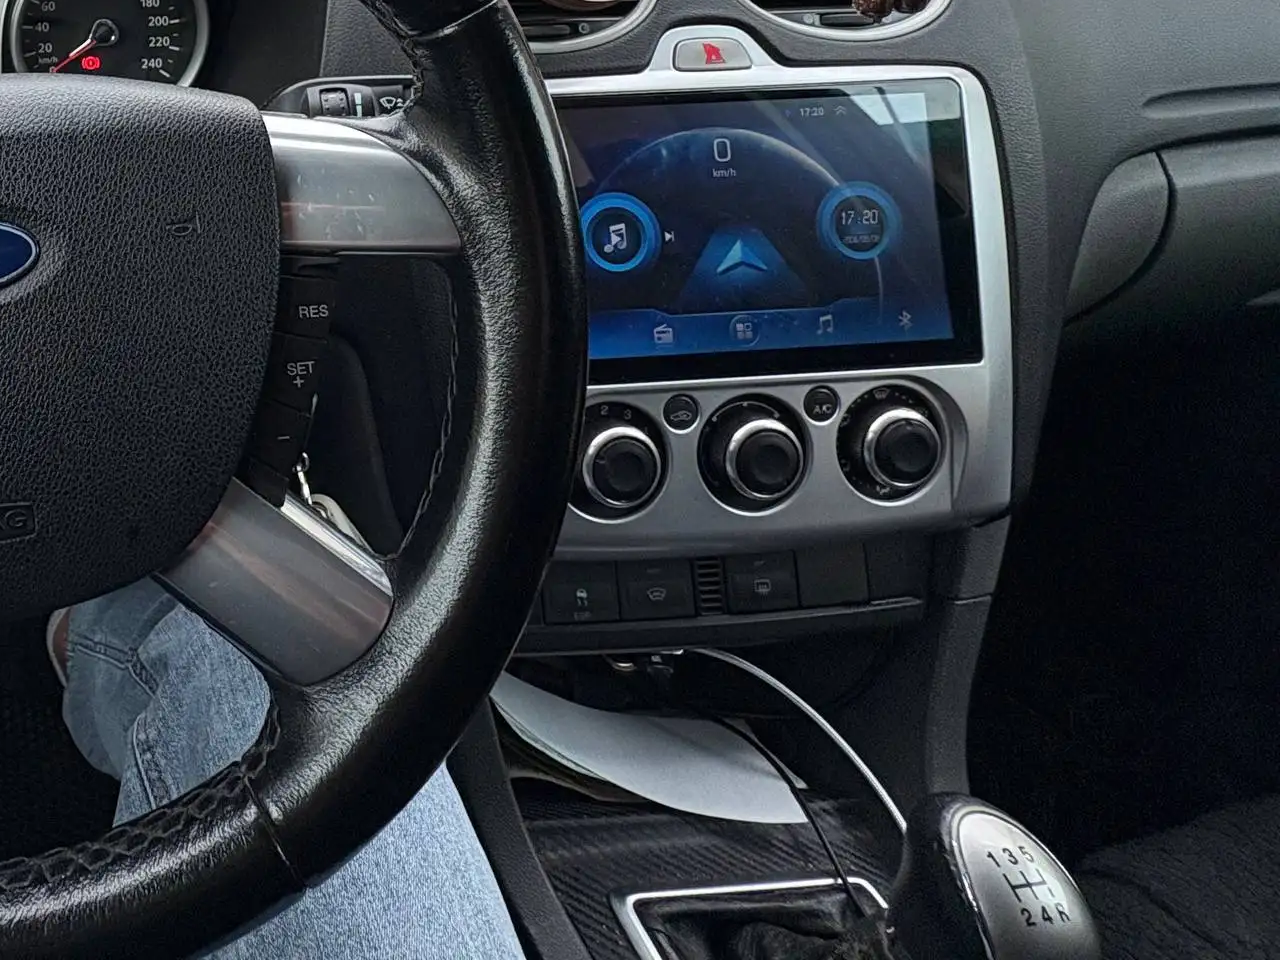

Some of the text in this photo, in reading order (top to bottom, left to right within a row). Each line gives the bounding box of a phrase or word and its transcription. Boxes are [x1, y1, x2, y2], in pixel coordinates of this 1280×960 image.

[41, 1, 56, 12] 60
[35, 22, 50, 32] 40
[148, 16, 169, 27] 200
[148, 36, 170, 47] 220
[38, 43, 53, 54] 20
[141, 58, 163, 69] 240
[799, 107, 825, 117] 17:20
[713, 138, 731, 162] 0
[712, 168, 737, 178] km/h
[841, 209, 879, 225] 17:20
[298, 304, 329, 319] RES
[286, 360, 315, 376] SET
[986, 845, 1035, 868] 1 3 5
[1020, 907, 1037, 927] 2
[1041, 905, 1054, 925] 4
